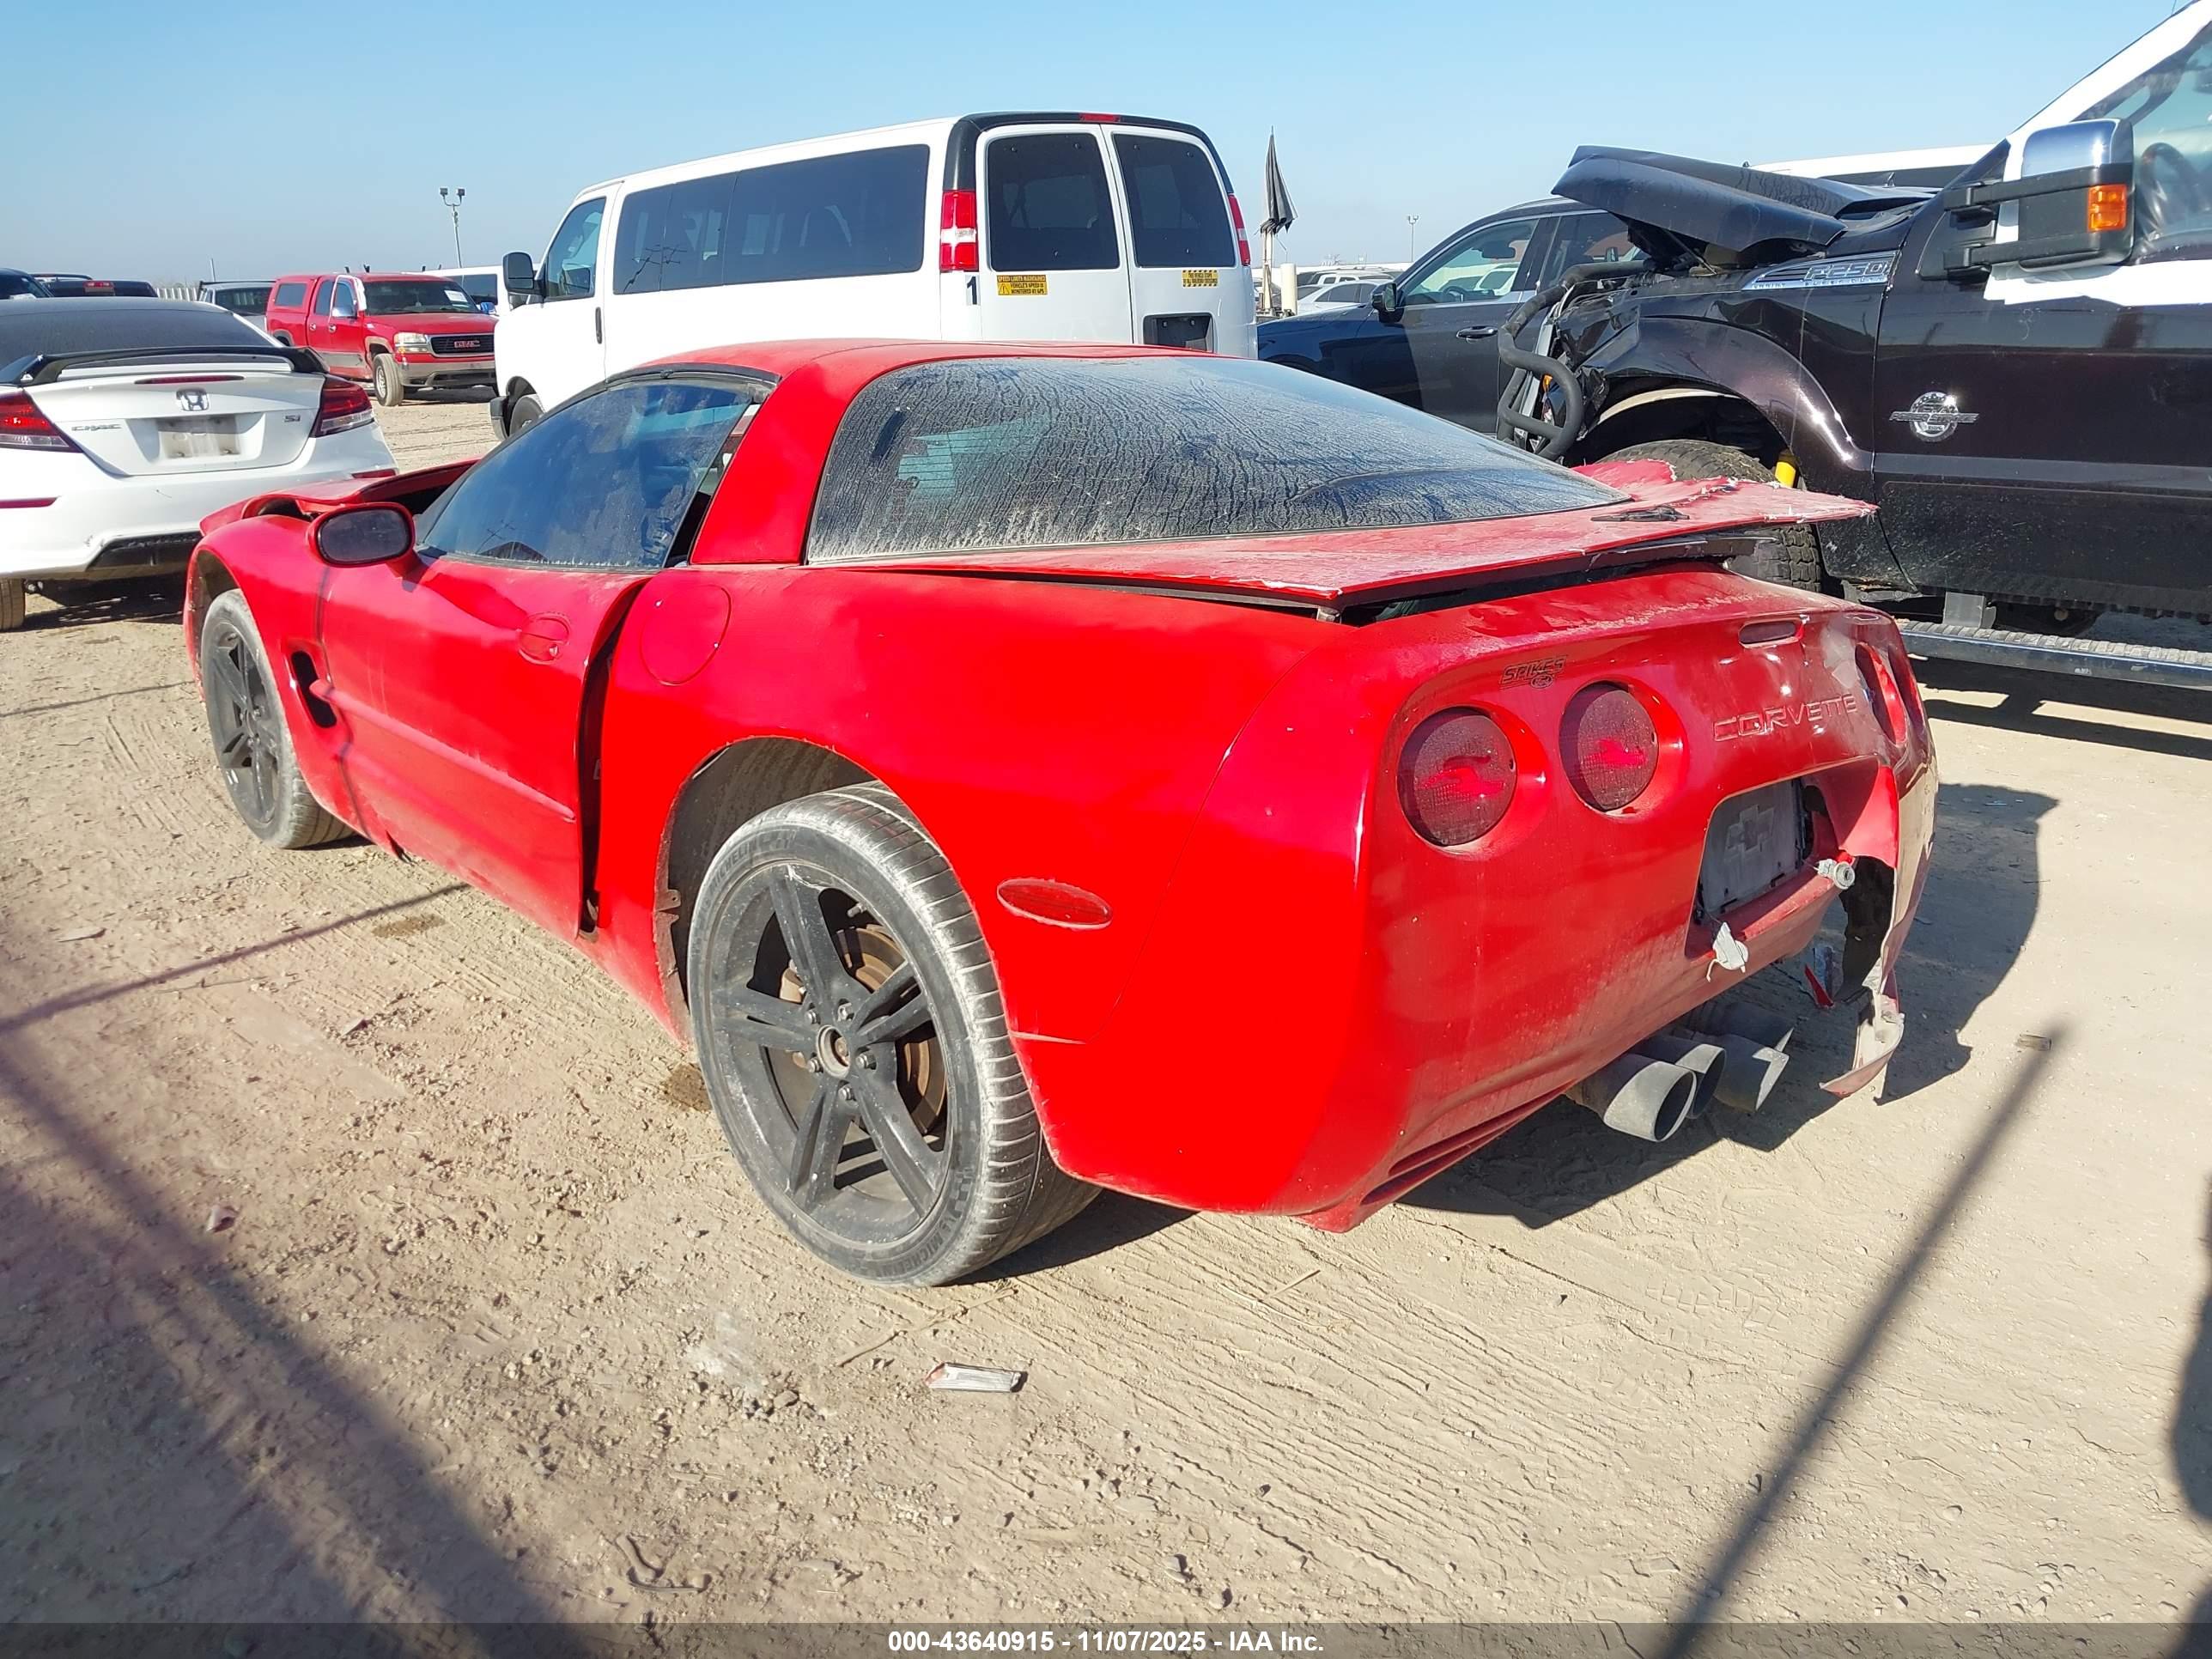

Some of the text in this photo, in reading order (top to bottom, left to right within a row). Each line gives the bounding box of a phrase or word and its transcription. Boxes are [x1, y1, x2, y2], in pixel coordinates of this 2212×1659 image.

[967, 276, 977, 305] 1
[1501, 655, 1567, 684] SPIKES
[1713, 693, 1857, 742] CORVETTE
